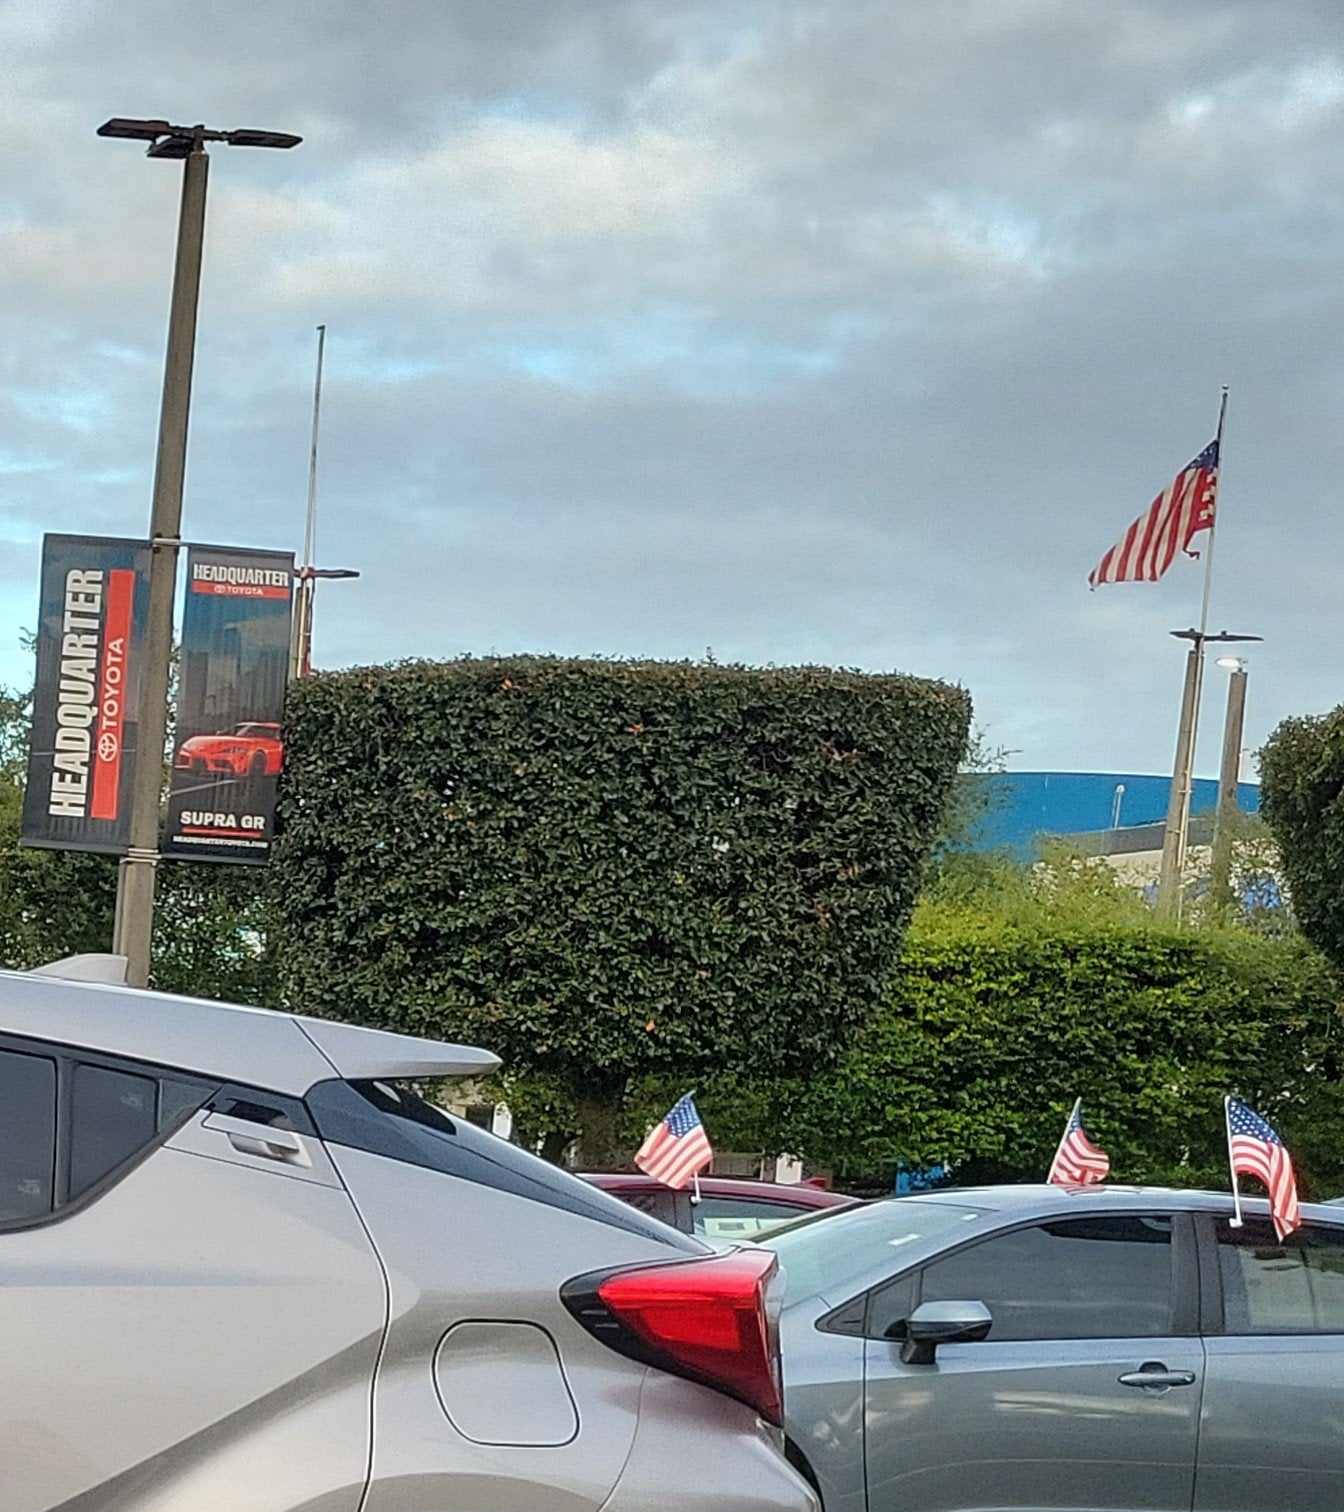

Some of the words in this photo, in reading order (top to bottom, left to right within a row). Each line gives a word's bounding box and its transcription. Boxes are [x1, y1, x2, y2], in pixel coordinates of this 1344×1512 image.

[193, 563, 289, 587] HEADQUARTER
[227, 584, 264, 596] TOYOTA
[48, 568, 104, 818] HEADQUARTER
[101, 637, 124, 731] TOYOTA
[180, 810, 237, 828] SUPRA
[240, 814, 266, 830] GR
